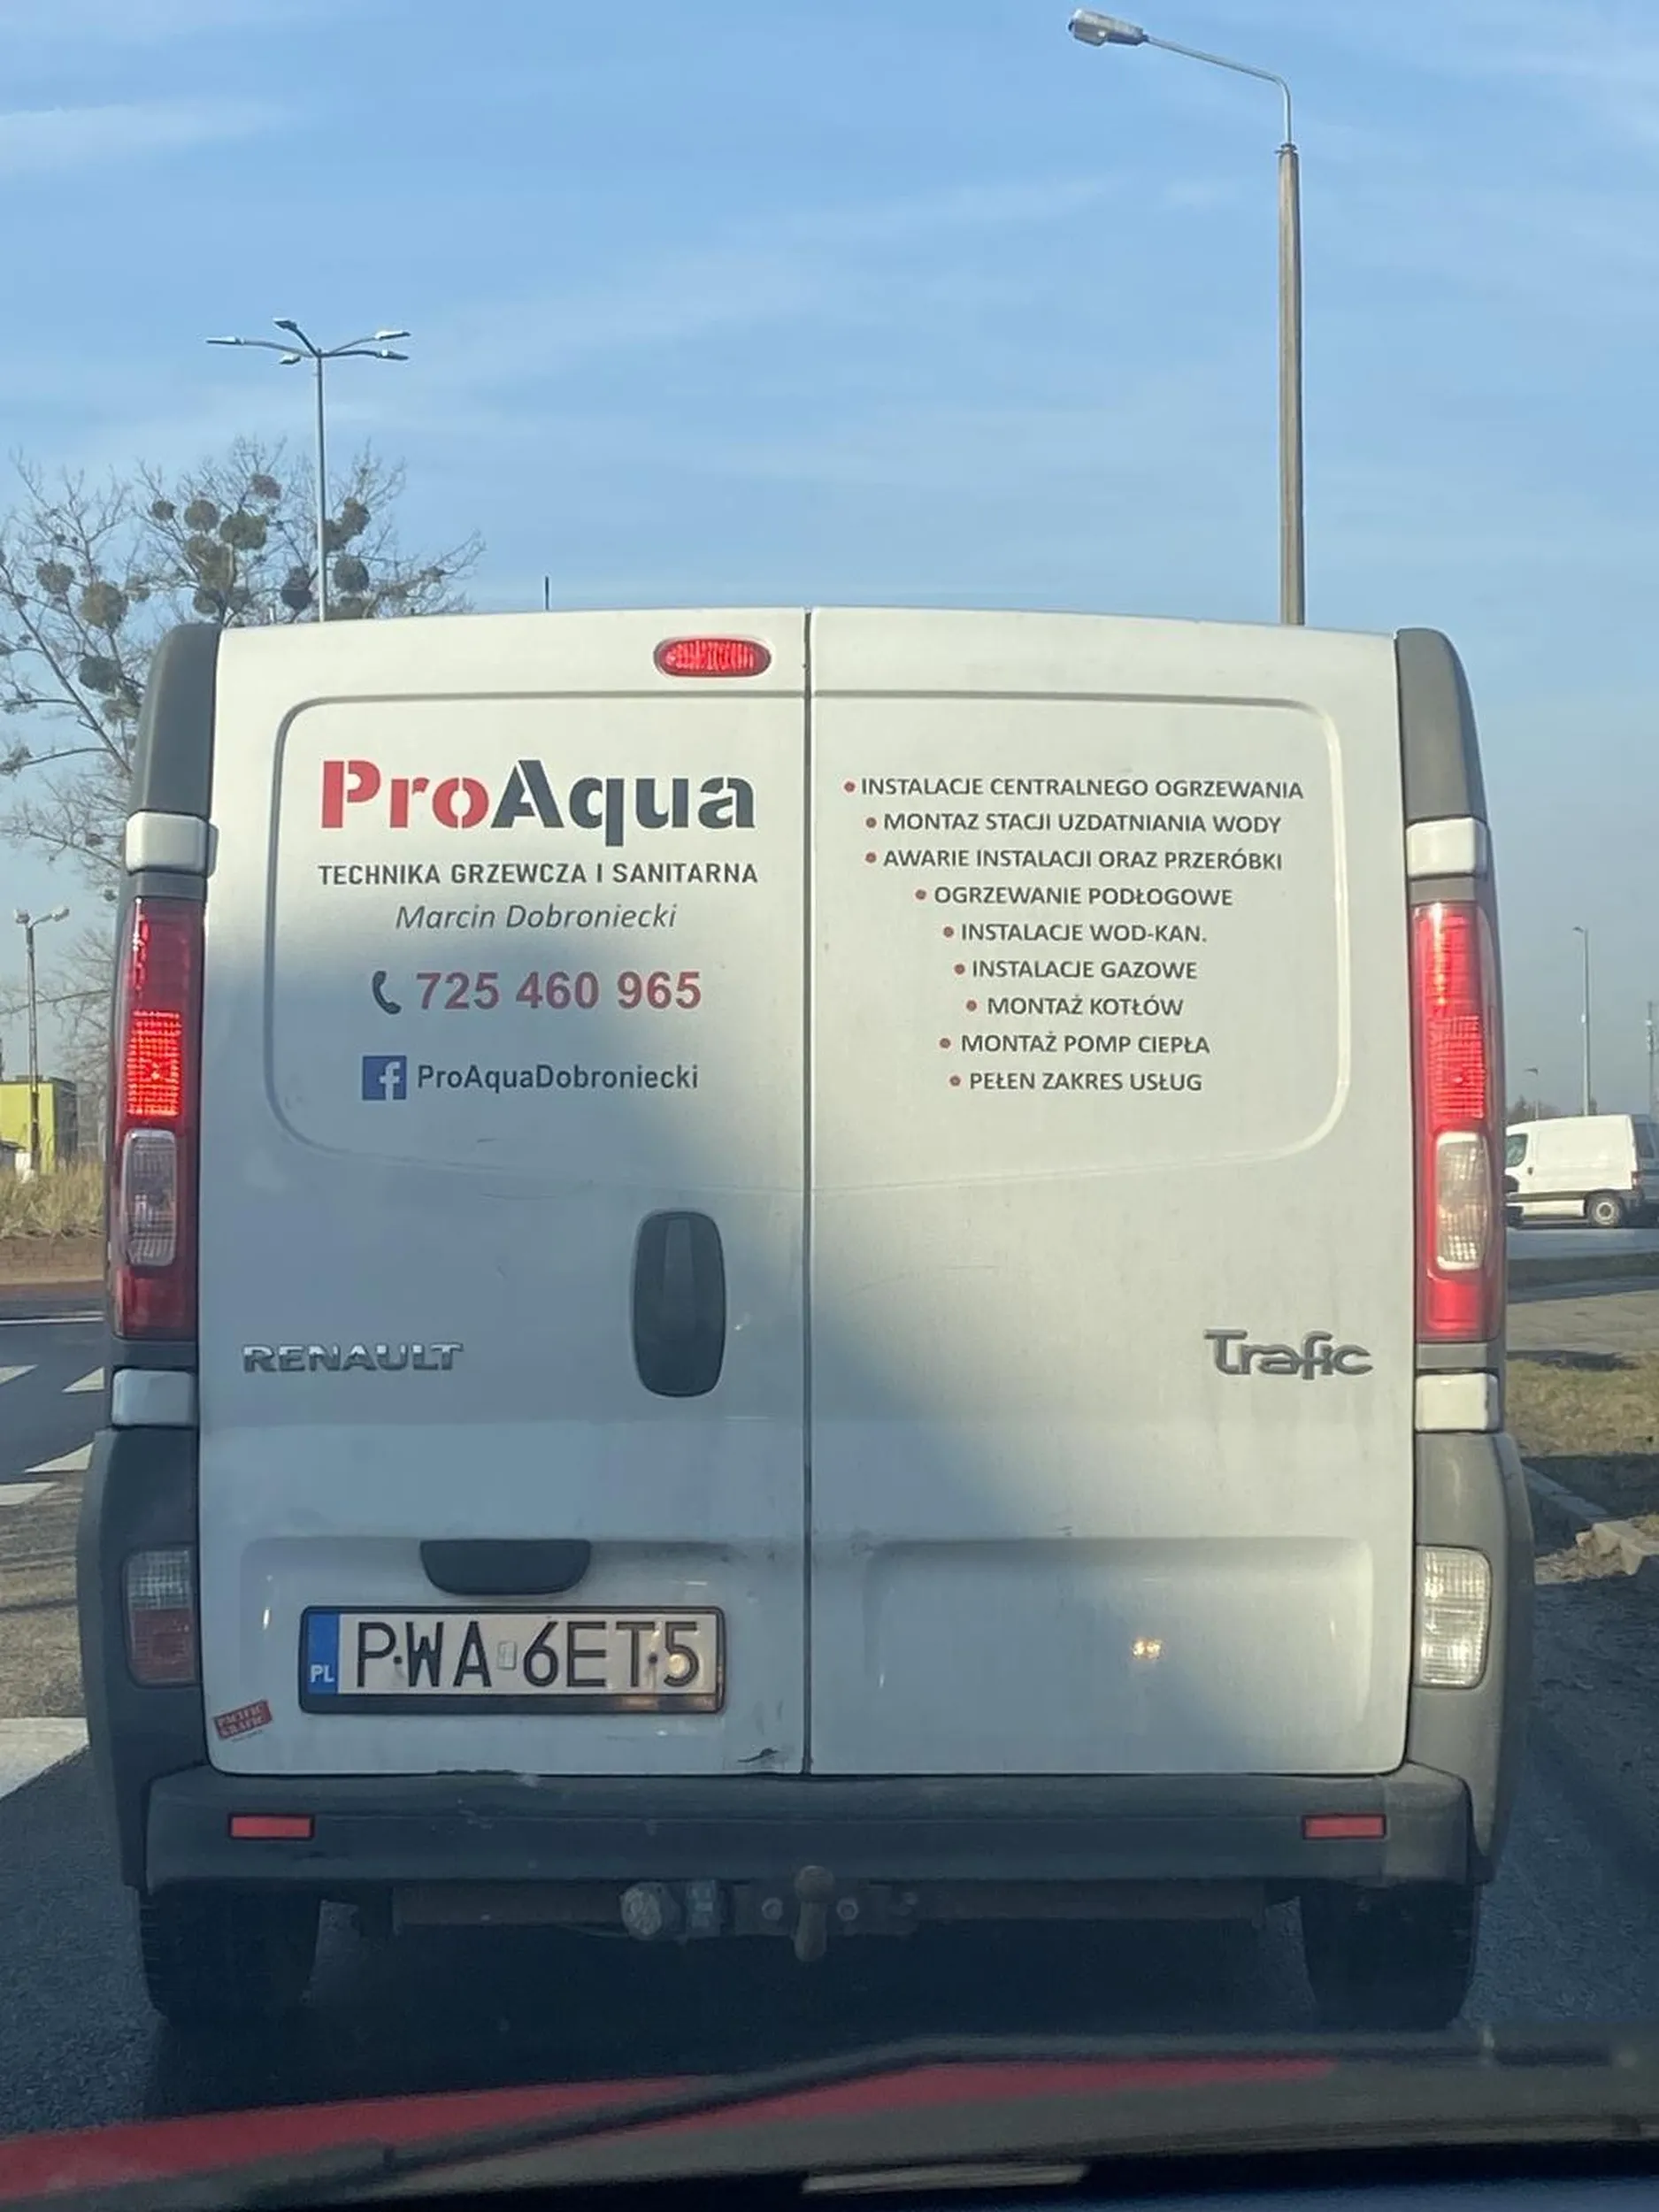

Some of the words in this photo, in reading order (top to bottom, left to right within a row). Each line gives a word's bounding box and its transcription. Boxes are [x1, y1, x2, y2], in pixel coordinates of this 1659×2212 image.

[862, 778, 983, 795] INSTALACJE
[990, 778, 1148, 796] CENTRALNEGO
[1156, 779, 1304, 799] OGRZEWANIA
[321, 759, 756, 848] ProAqua
[885, 813, 979, 830] MONTAZ
[986, 813, 1050, 830] STACJI
[1058, 814, 1206, 833] UZDATNIANIA
[1213, 815, 1281, 833] WODY
[883, 849, 970, 867] AWARIE
[977, 849, 1091, 868] INSTALACJI
[1099, 850, 1157, 868] ORAZ
[1165, 848, 1282, 871] PRZERÓBKI
[319, 864, 441, 885] TECHNIKA
[451, 863, 587, 884] GRZEWCZA
[596, 864, 603, 883] I
[612, 863, 758, 884] SANITARNA
[934, 887, 1081, 904] OGRZEWANIE
[1089, 887, 1233, 906] PODŁOGOWE
[396, 903, 495, 930] Marcin
[506, 902, 678, 929] Dobroniecki
[962, 923, 1083, 941] INSTALACJE
[1090, 924, 1207, 942] WOD-KAN.
[972, 960, 1094, 978] INSTALACJE
[1101, 961, 1197, 979] GAZOWE
[417, 972, 499, 1010] 725
[516, 972, 599, 1010] 460
[618, 971, 702, 1010] 965
[987, 994, 1083, 1015] MONTAŻ
[1090, 995, 1184, 1016] KOTŁÓW
[962, 1031, 1057, 1052] MONTAŻ
[1064, 1034, 1131, 1053] POMP
[1138, 1036, 1210, 1054] CIEPŁA
[418, 1064, 698, 1094] ProAquaDobroniecki
[970, 1072, 1035, 1090] PEŁEN
[1042, 1072, 1123, 1090] ZAKRES
[1130, 1073, 1202, 1091] USŁUG
[242, 1341, 464, 1373] RENAULT
[1203, 1329, 1373, 1380] Trafic
[311, 1664, 334, 1683] PL
[356, 1621, 492, 1687] PWA
[523, 1621, 699, 1687] 6ET5
